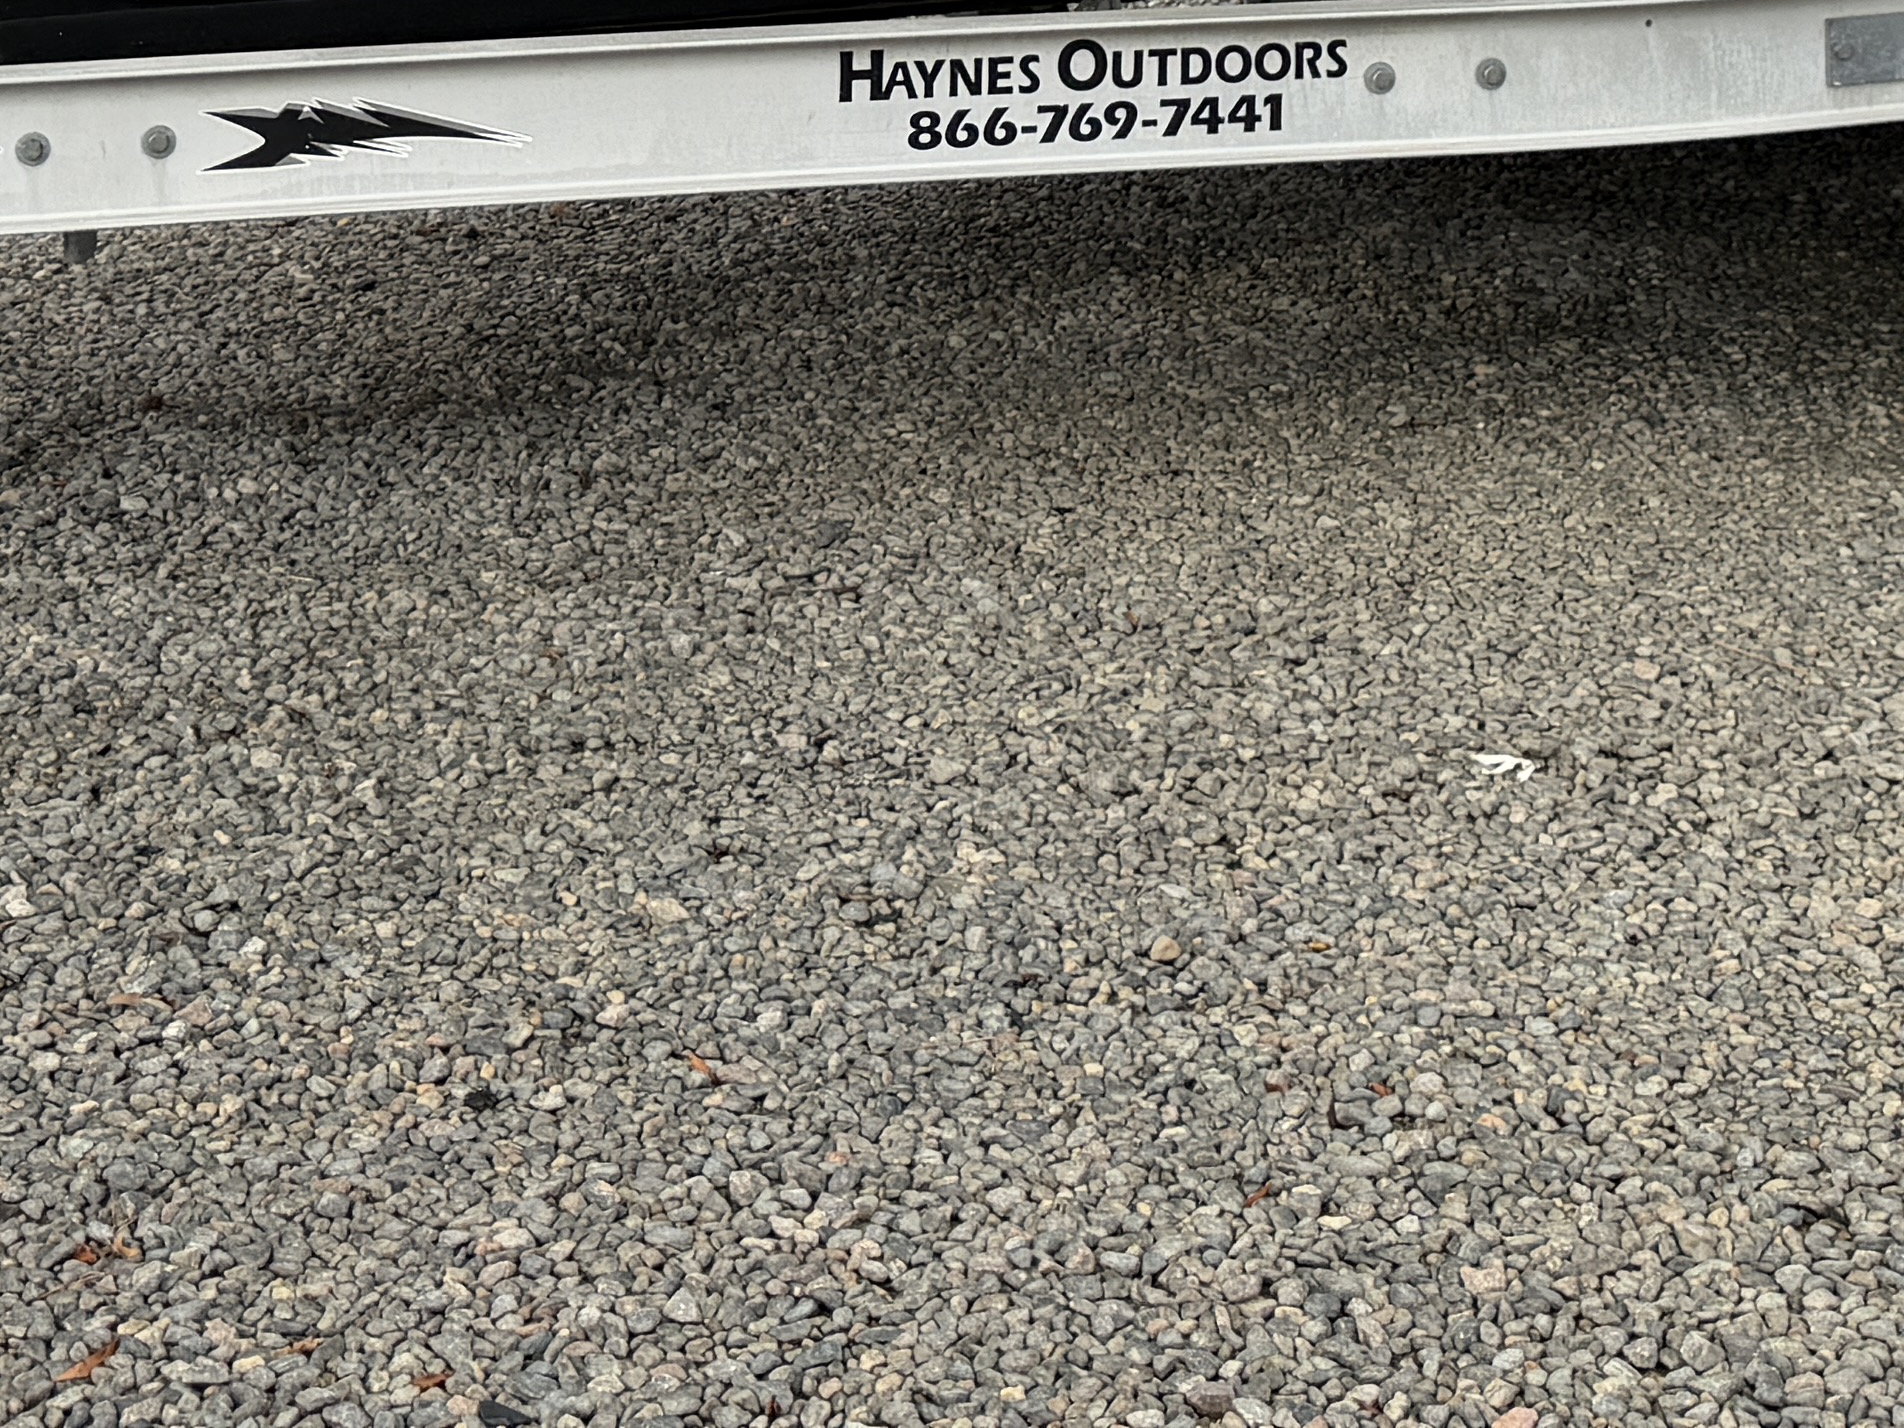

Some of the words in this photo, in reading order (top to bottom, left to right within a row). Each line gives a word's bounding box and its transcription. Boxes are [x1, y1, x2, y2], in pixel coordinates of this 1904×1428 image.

[837, 48, 1042, 103] HAYNES
[1056, 38, 1349, 91] OUTDOORS
[906, 92, 1285, 151] 866-769-7441
